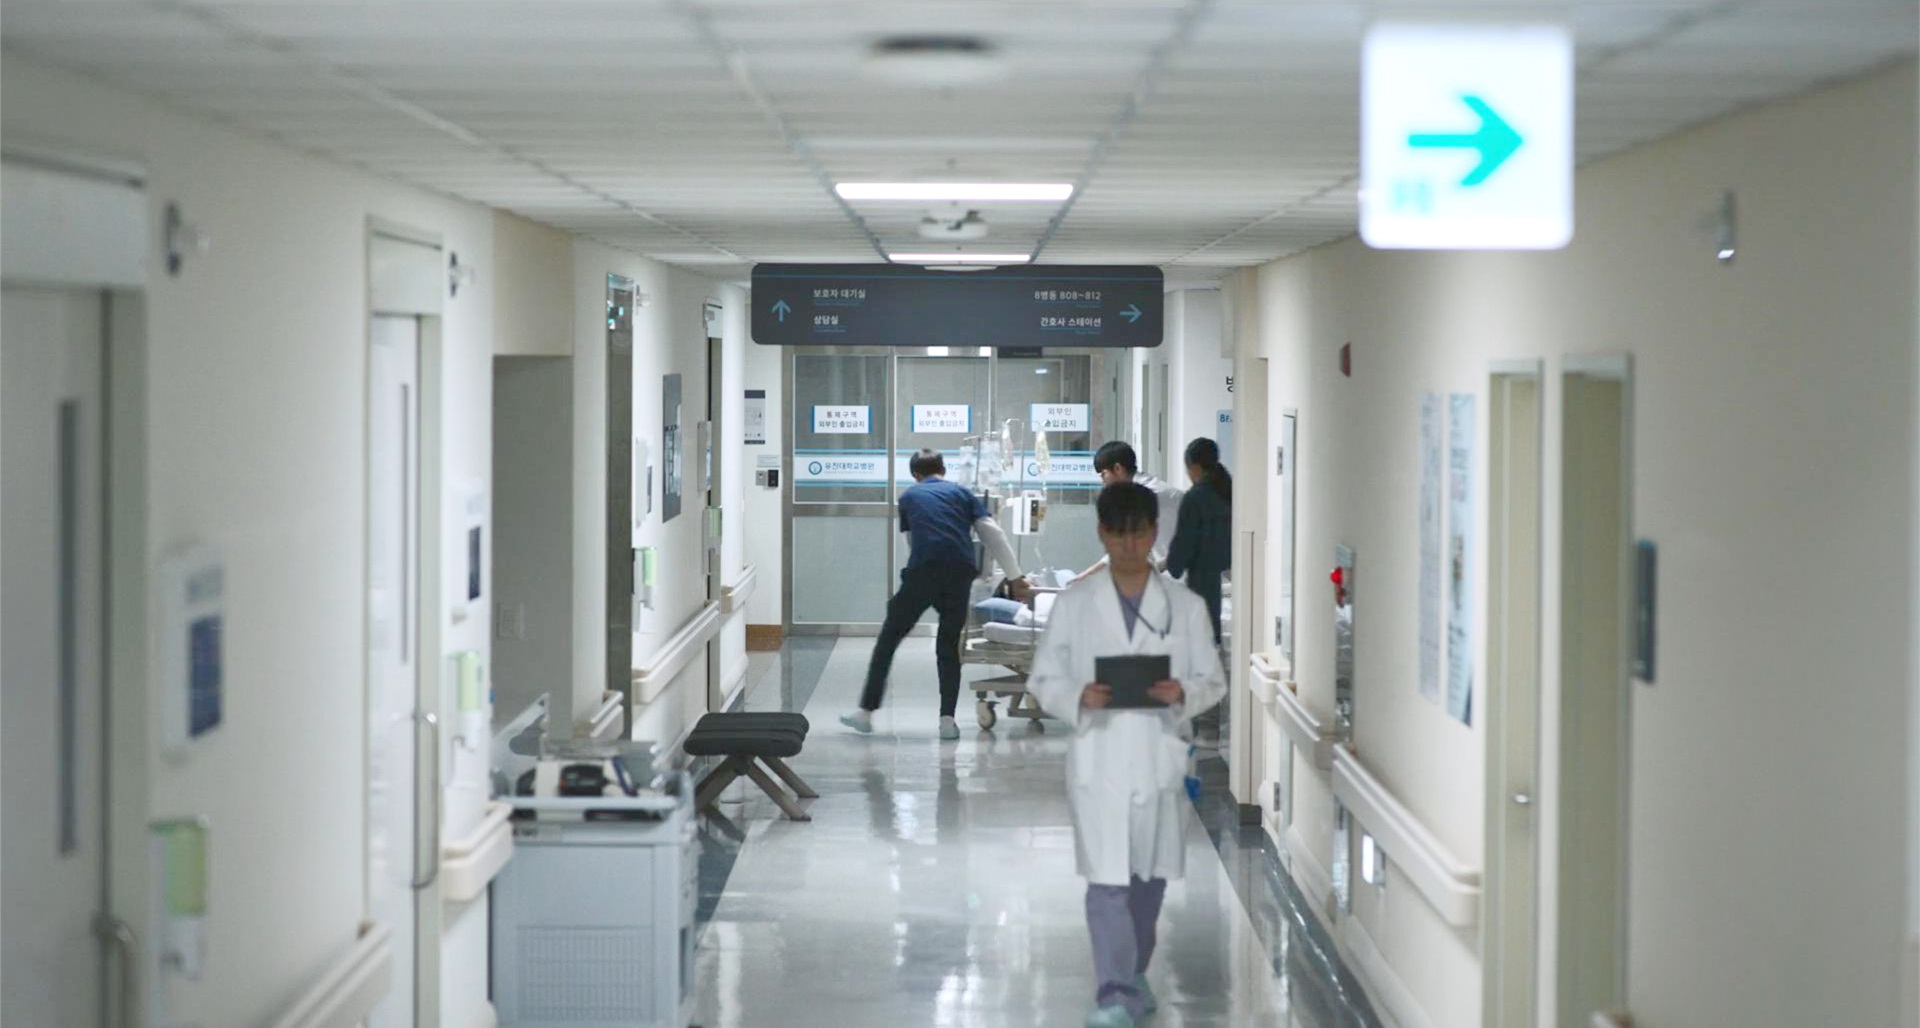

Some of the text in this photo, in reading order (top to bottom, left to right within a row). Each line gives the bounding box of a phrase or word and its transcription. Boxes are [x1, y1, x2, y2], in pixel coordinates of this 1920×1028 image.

[814, 288, 866, 299] 보호자 대기실
[1034, 290, 1101, 301] 8병동 808~812
[813, 315, 839, 325] 상담실
[1040, 316, 1101, 327] 간호사 스테이션
[1047, 407, 1072, 416] 외부인
